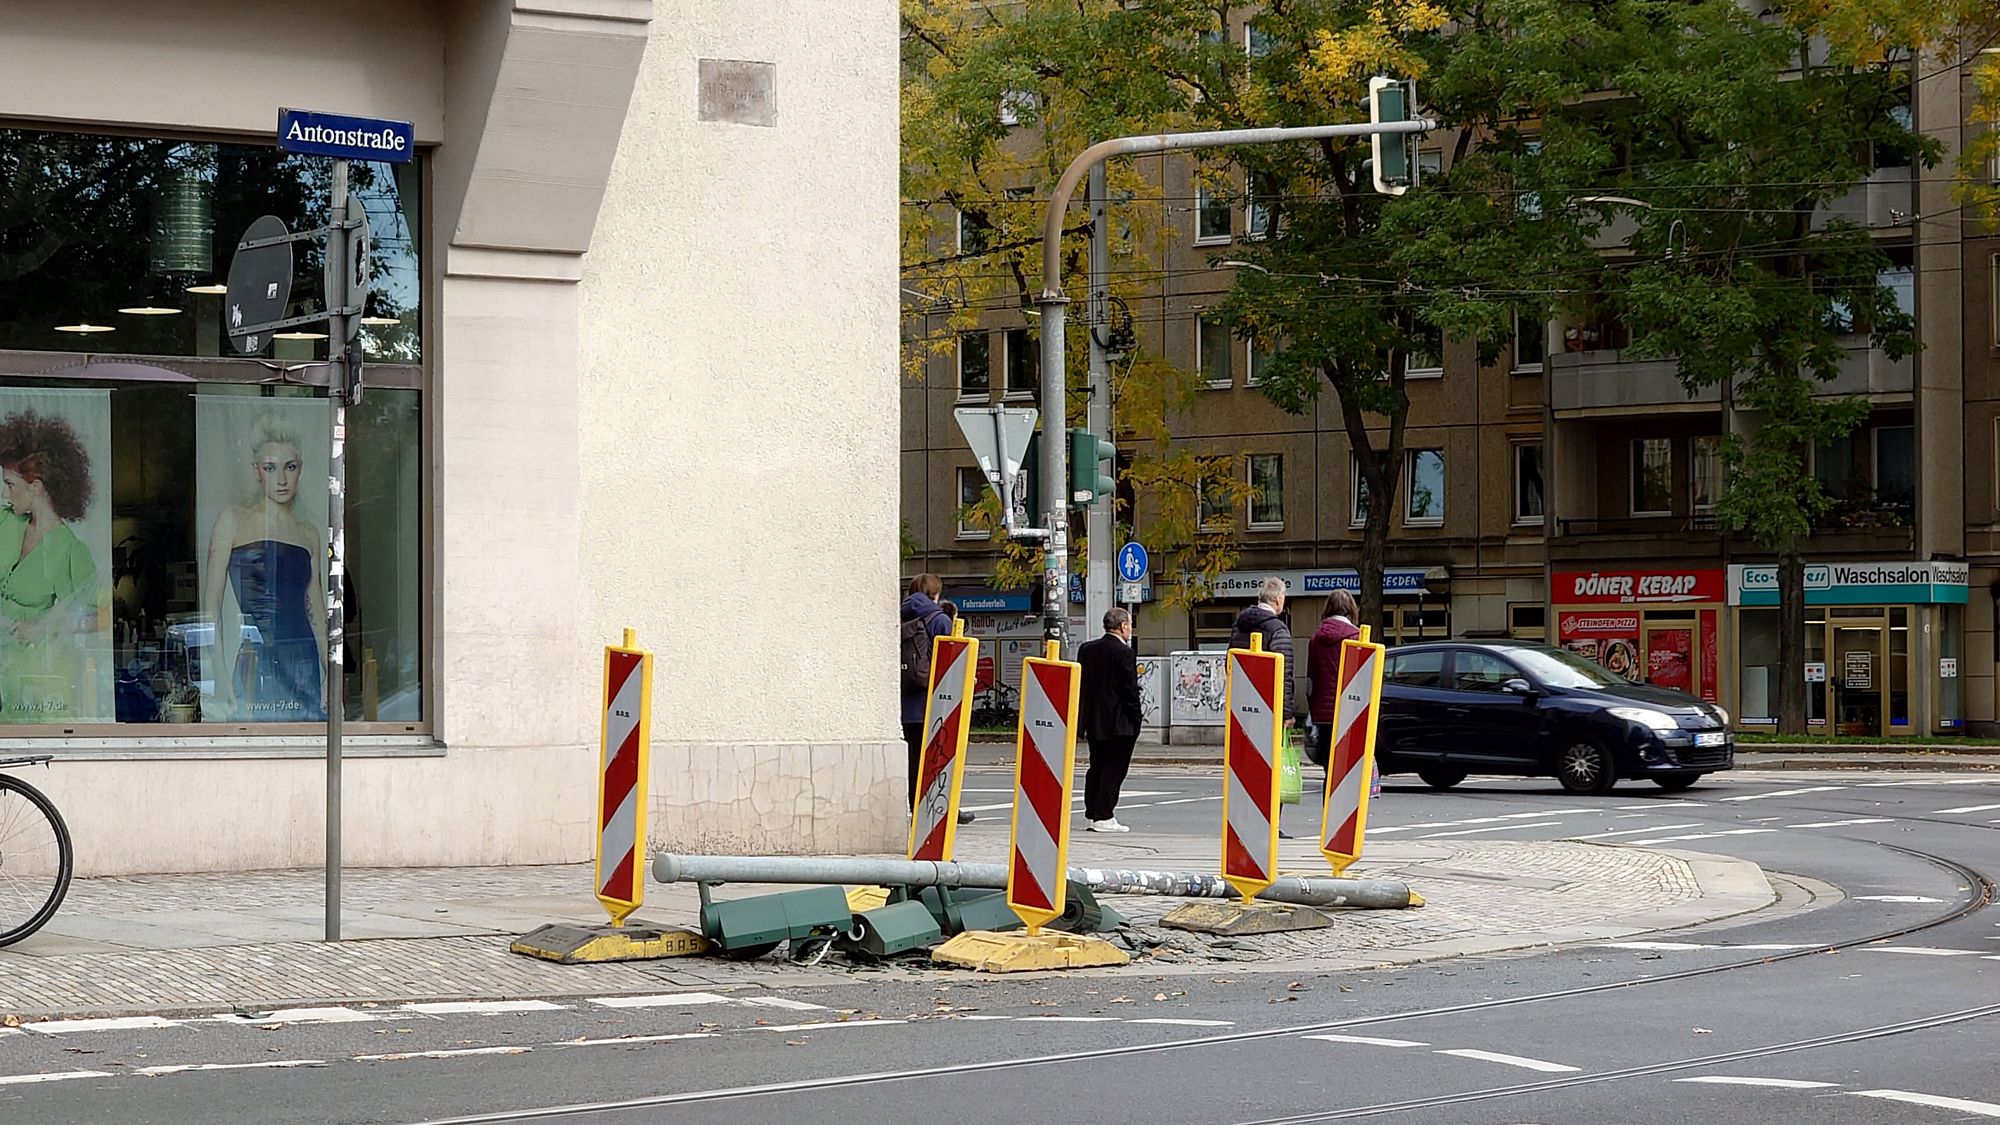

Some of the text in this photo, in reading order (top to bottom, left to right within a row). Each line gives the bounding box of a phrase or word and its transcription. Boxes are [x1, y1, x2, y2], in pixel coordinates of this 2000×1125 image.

[286, 120, 405, 151] Antonstraße
[1746, 570, 1826, 583] Eco-ess
[1834, 566, 1930, 584] Waschsalon
[1931, 565, 1968, 583] Waschsalon
[1306, 575, 1360, 588] TREBERHIL
[1574, 573, 1697, 596] DÖNER KEBAP
[962, 599, 1006, 609] Fahrradverleih
[1616, 618, 1636, 628] PIZZA
[12, 701, 68, 712] www.j-7.de
[245, 700, 300, 711] www.j-7.de
[665, 939, 701, 953] B.A.S.
